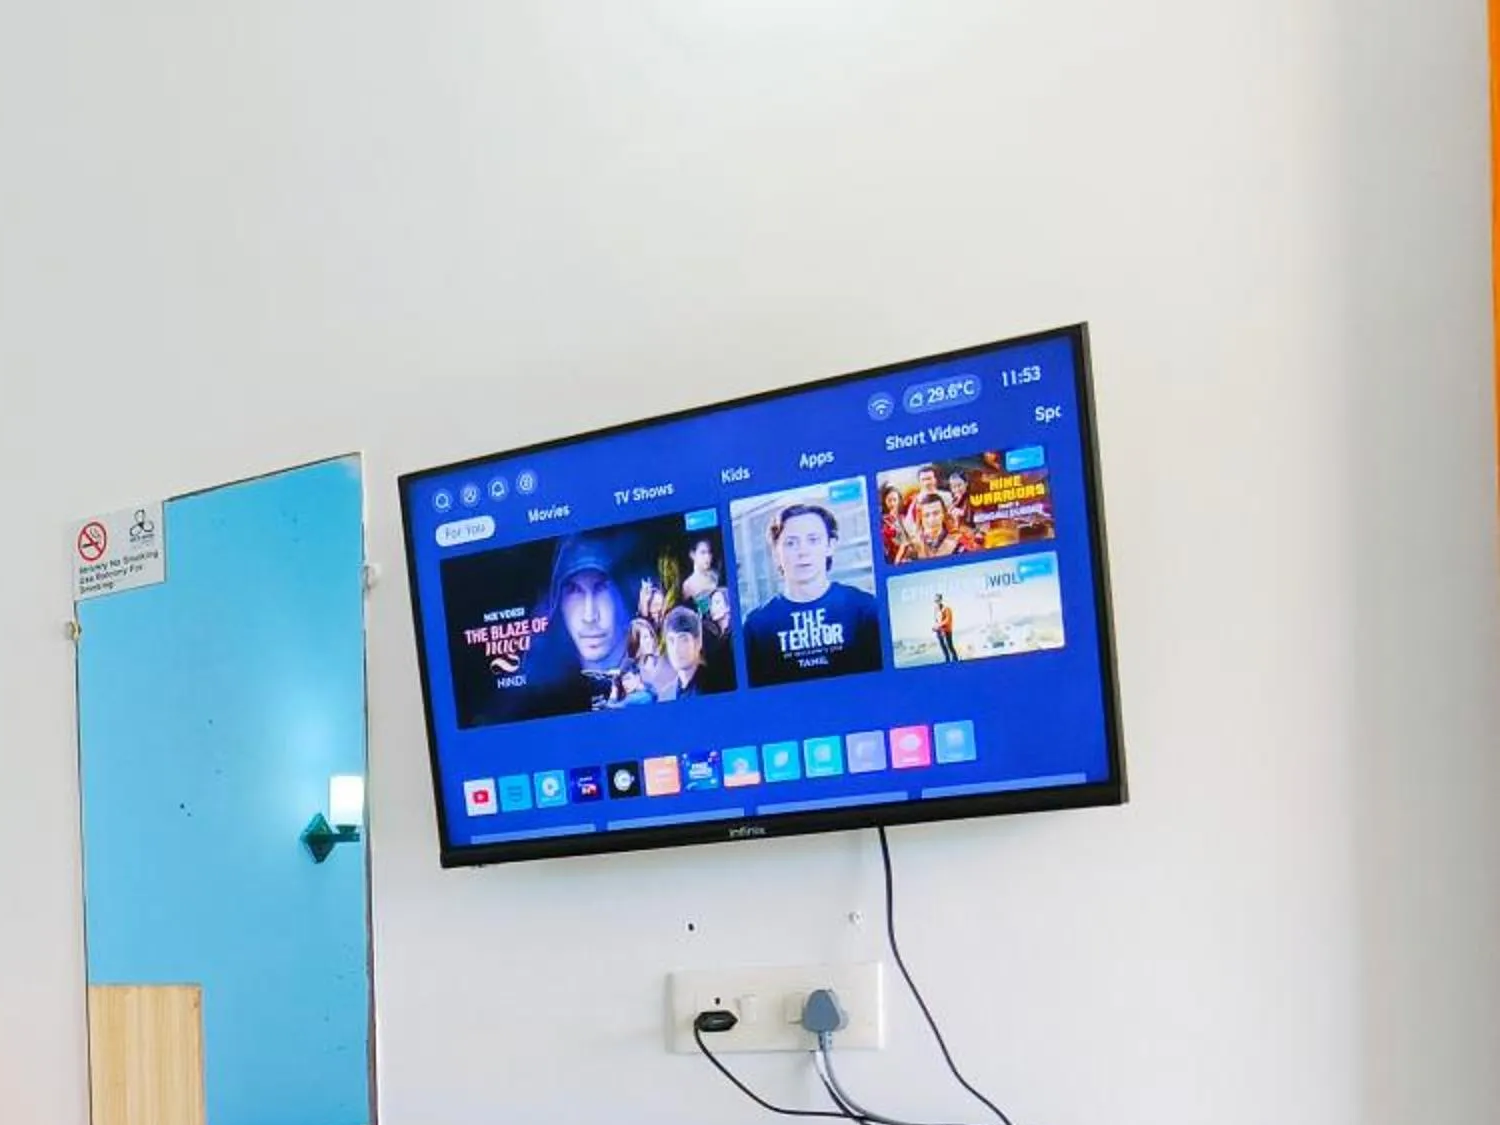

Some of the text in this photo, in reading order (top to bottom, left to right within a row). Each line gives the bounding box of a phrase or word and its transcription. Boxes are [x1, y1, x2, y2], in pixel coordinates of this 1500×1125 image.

[1002, 365, 1042, 387] 11:53
[885, 421, 979, 451] Short Videos
[799, 450, 835, 470] Apps
[720, 467, 751, 485] Kids
[613, 482, 675, 505] TV Shows
[527, 503, 571, 523] Movies
[444, 523, 487, 541] For You
[990, 571, 1023, 588] WOL
[464, 616, 549, 645] THE BLAZE OF
[789, 607, 827, 632] THE
[777, 622, 845, 653] TERROR
